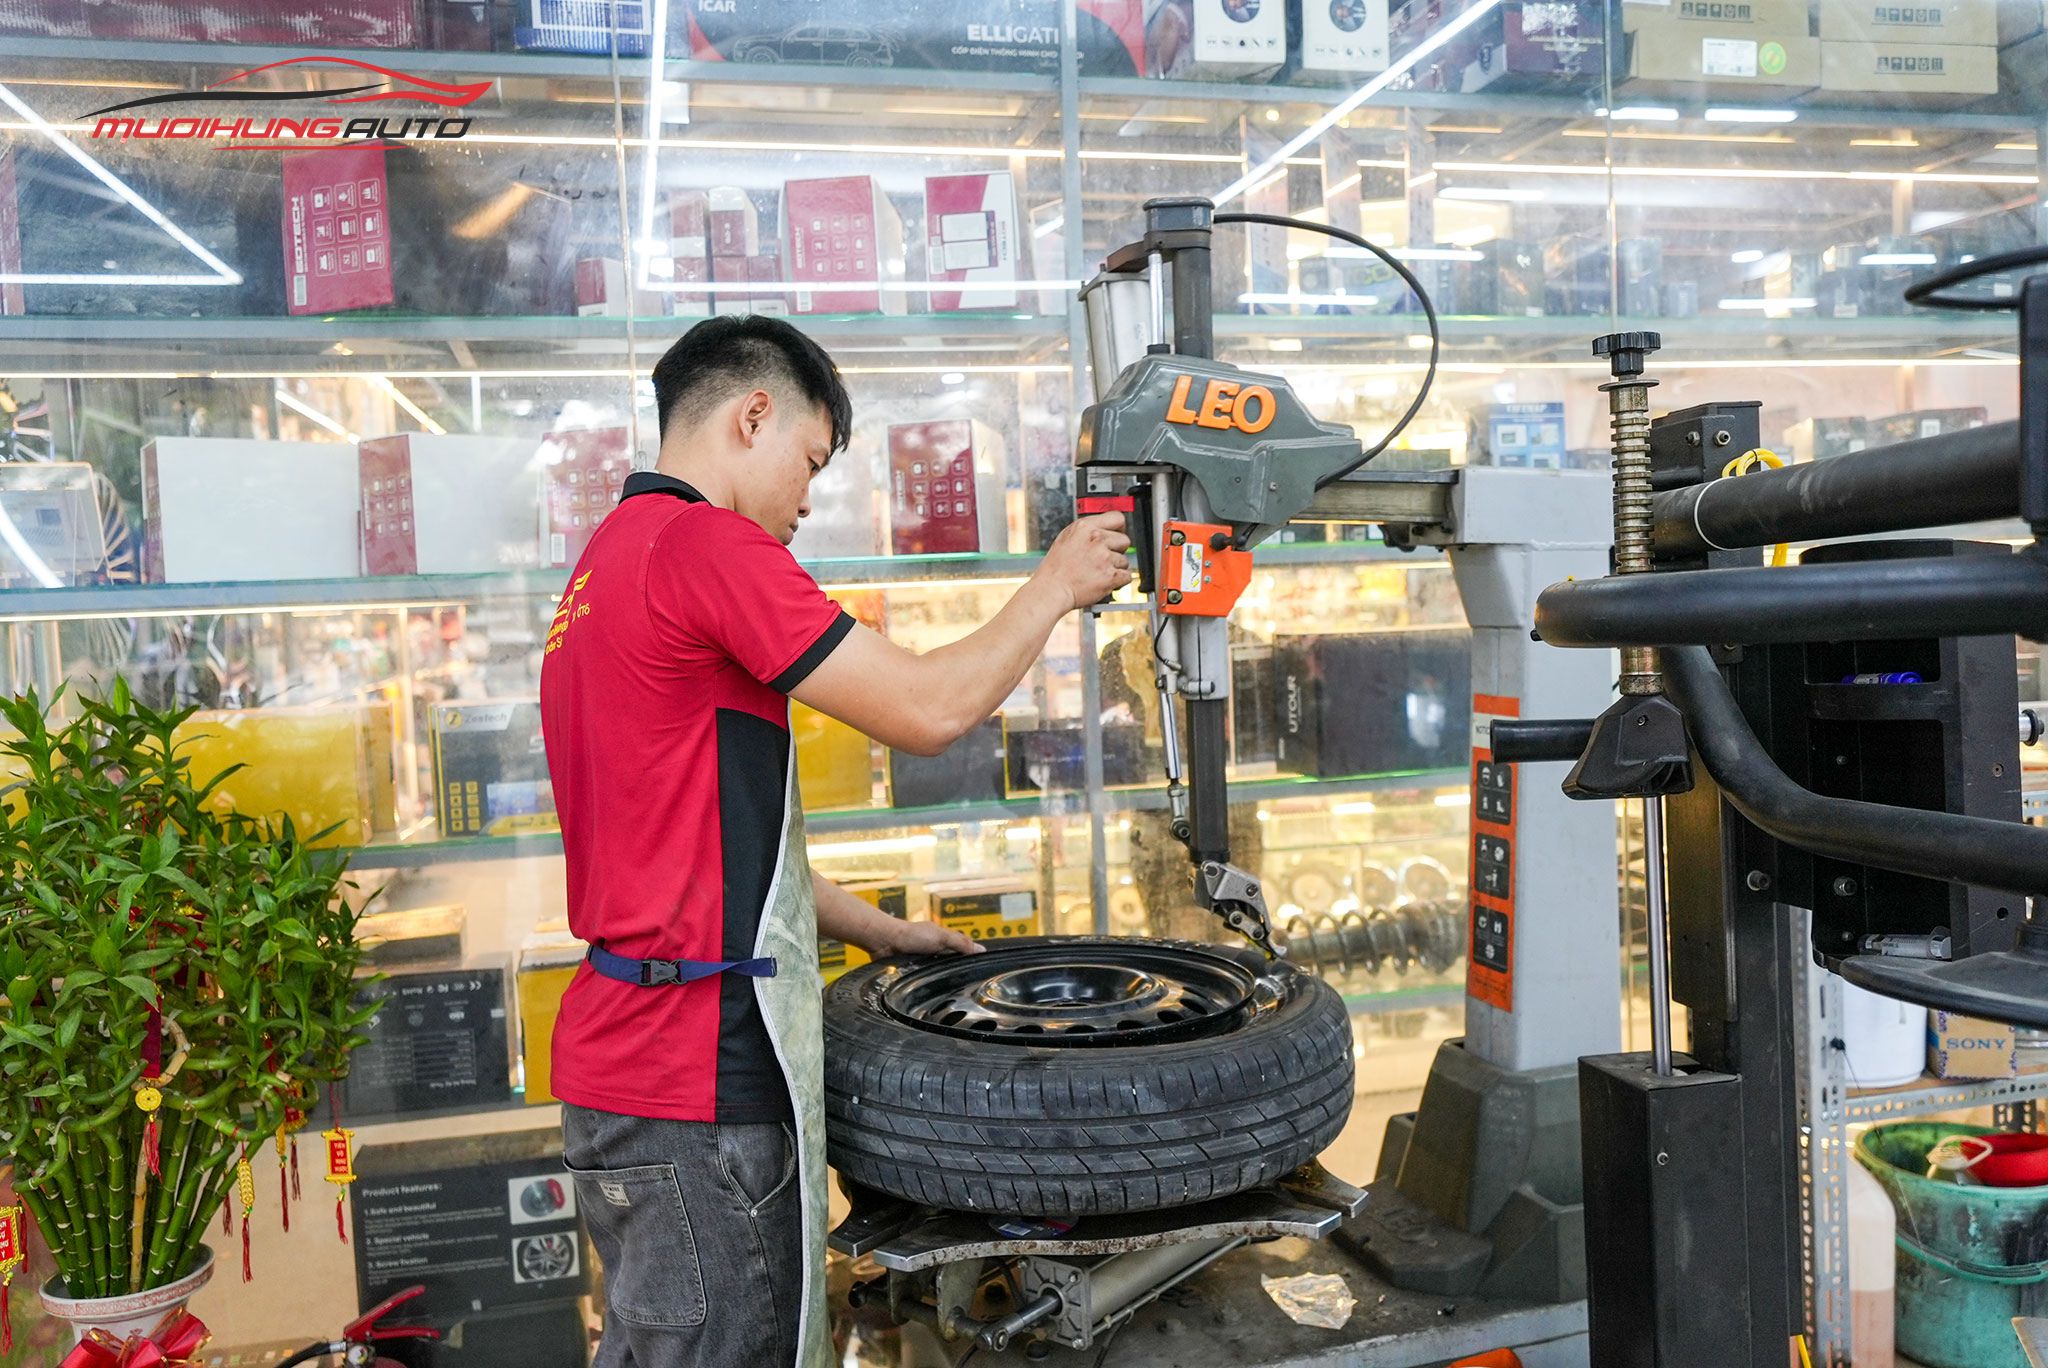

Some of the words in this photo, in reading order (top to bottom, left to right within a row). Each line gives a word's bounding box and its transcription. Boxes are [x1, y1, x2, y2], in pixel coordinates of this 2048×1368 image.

[1166, 375, 1277, 434] LEO
[1286, 675, 1299, 733] UTOUR
[1946, 1038, 2006, 1050] SONY
[362, 1185, 399, 1198] Product
